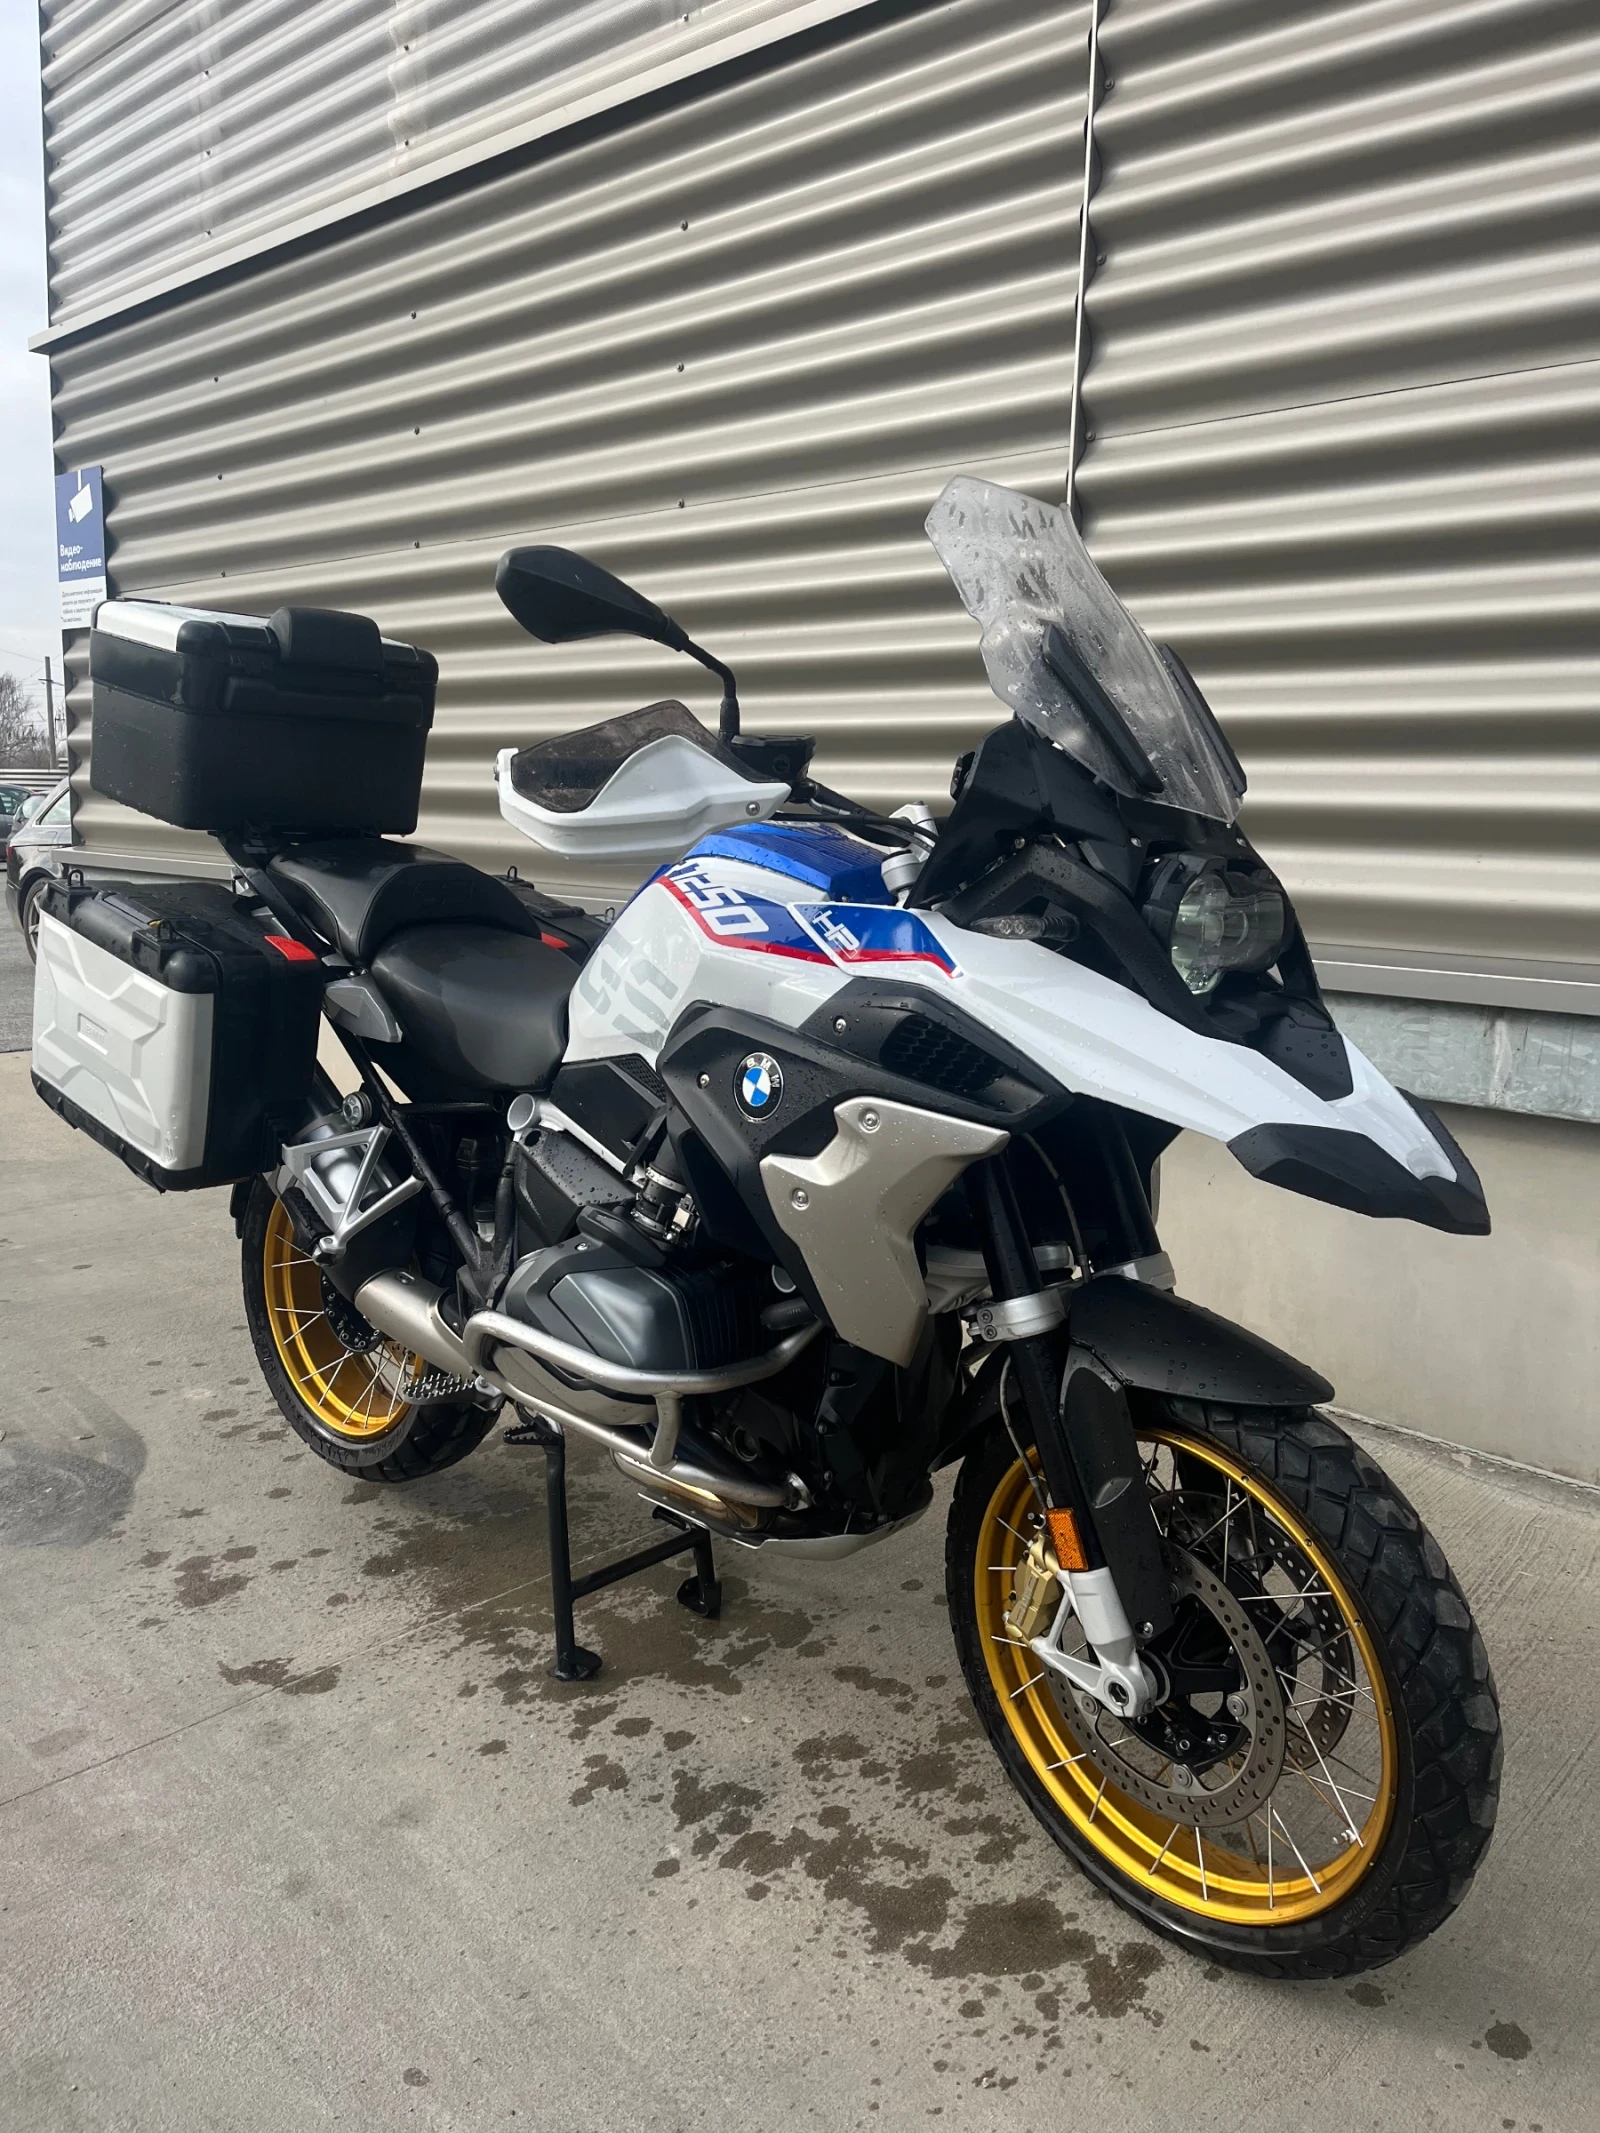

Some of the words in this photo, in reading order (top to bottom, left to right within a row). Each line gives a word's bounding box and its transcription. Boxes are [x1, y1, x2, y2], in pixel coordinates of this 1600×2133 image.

[60, 544, 84, 558] Видео-
[60, 557, 102, 573] наблюдение
[811, 909, 861, 958] HP
[745, 1056, 781, 1088] BMW
